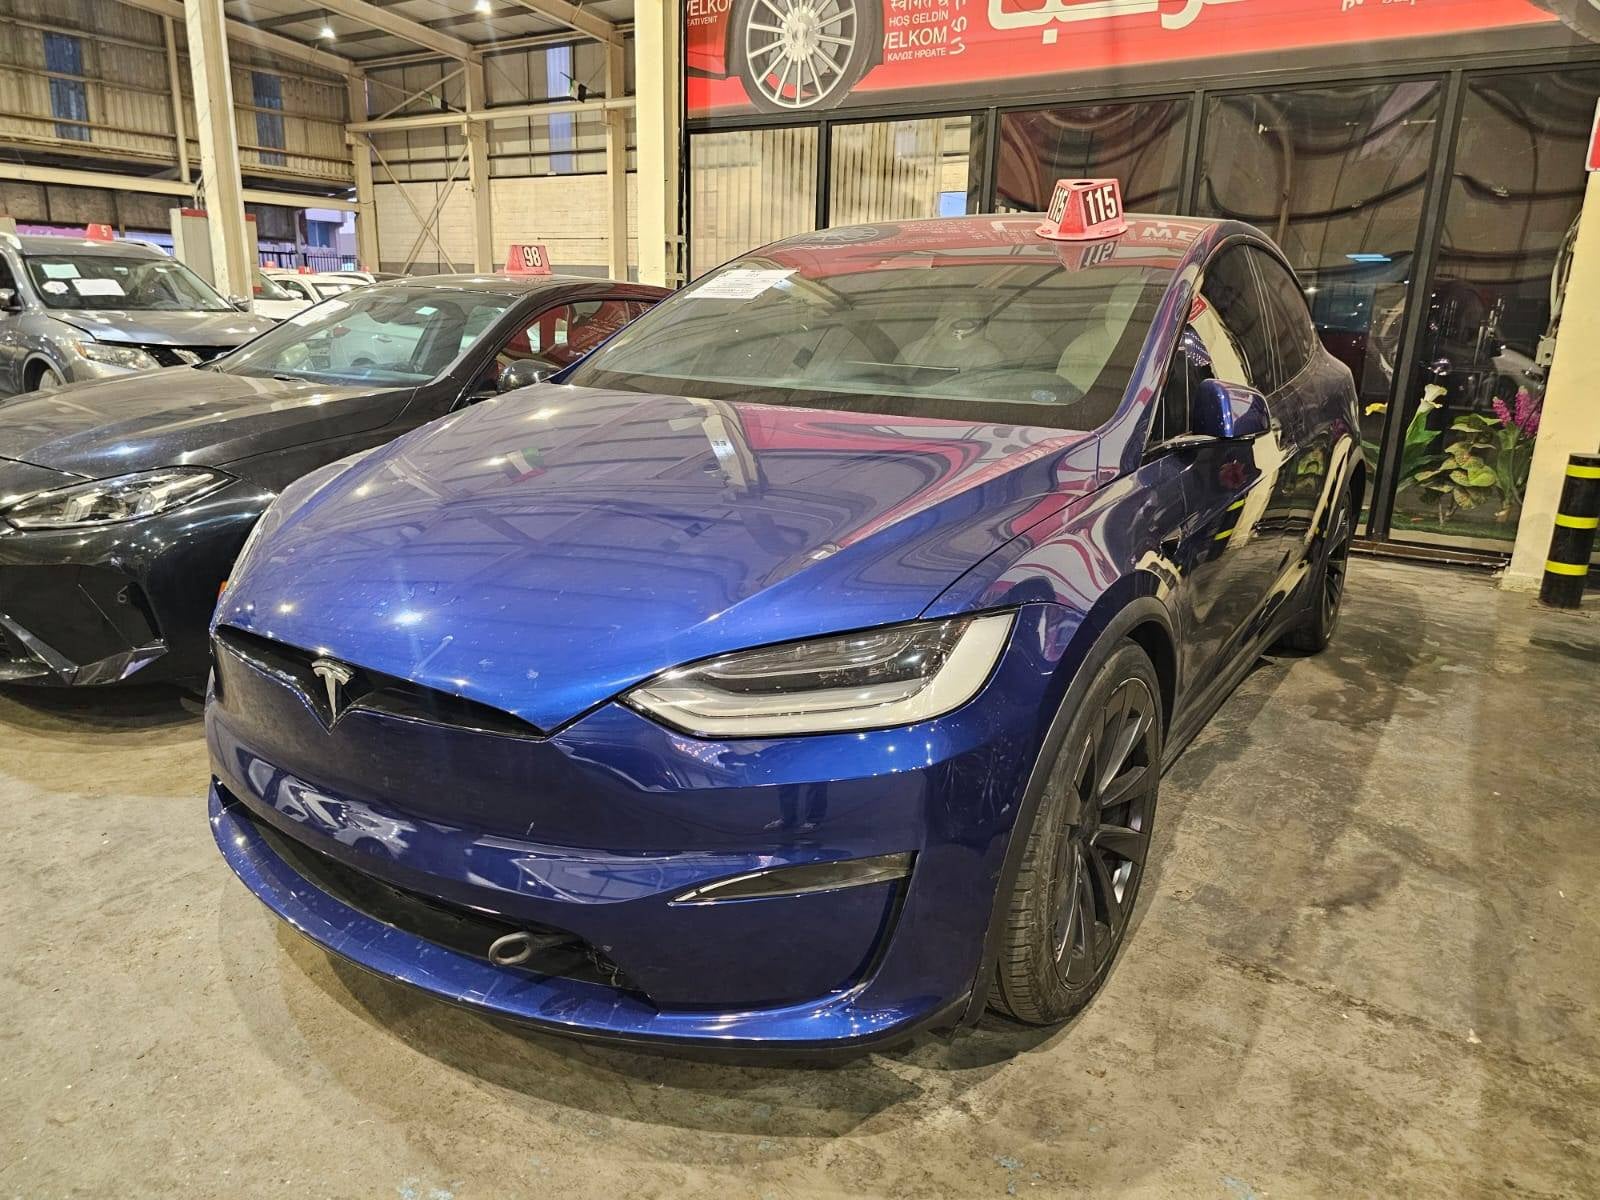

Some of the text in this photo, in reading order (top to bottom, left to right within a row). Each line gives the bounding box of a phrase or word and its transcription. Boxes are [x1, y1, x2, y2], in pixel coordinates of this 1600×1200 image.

[687, 0, 732, 16] ELKO
[1049, 187, 1068, 223] 115
[1086, 185, 1117, 224] 115
[523, 246, 542, 267] 98
